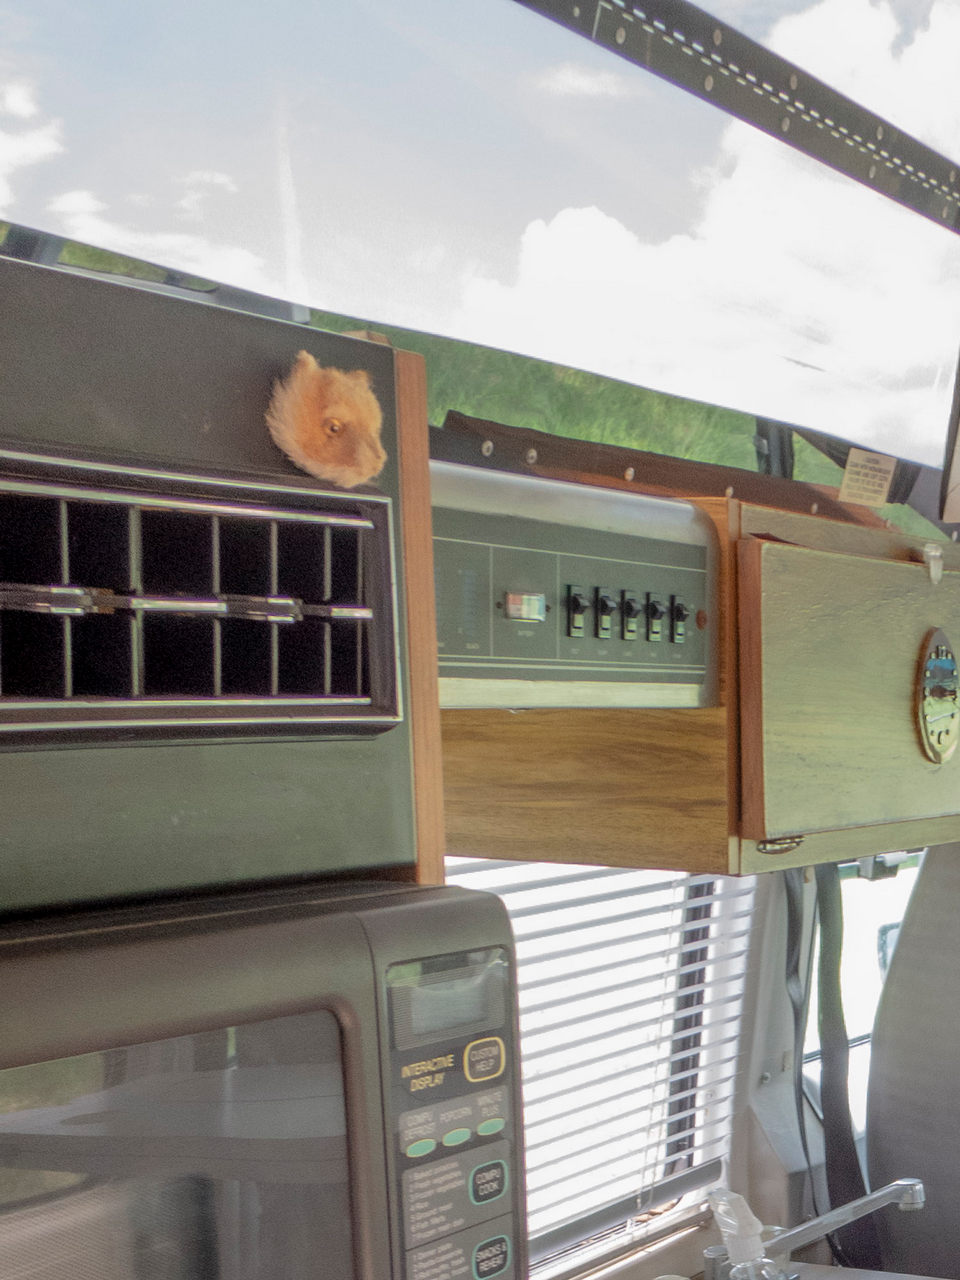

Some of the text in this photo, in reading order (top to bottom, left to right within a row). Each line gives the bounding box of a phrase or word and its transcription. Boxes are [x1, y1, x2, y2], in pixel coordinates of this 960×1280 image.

[401, 1053, 455, 1079] INTERACTIVE
[476, 1058, 496, 1072] HELP
[410, 1072, 445, 1093] DISPLAY
[478, 1183, 499, 1196] COOK
